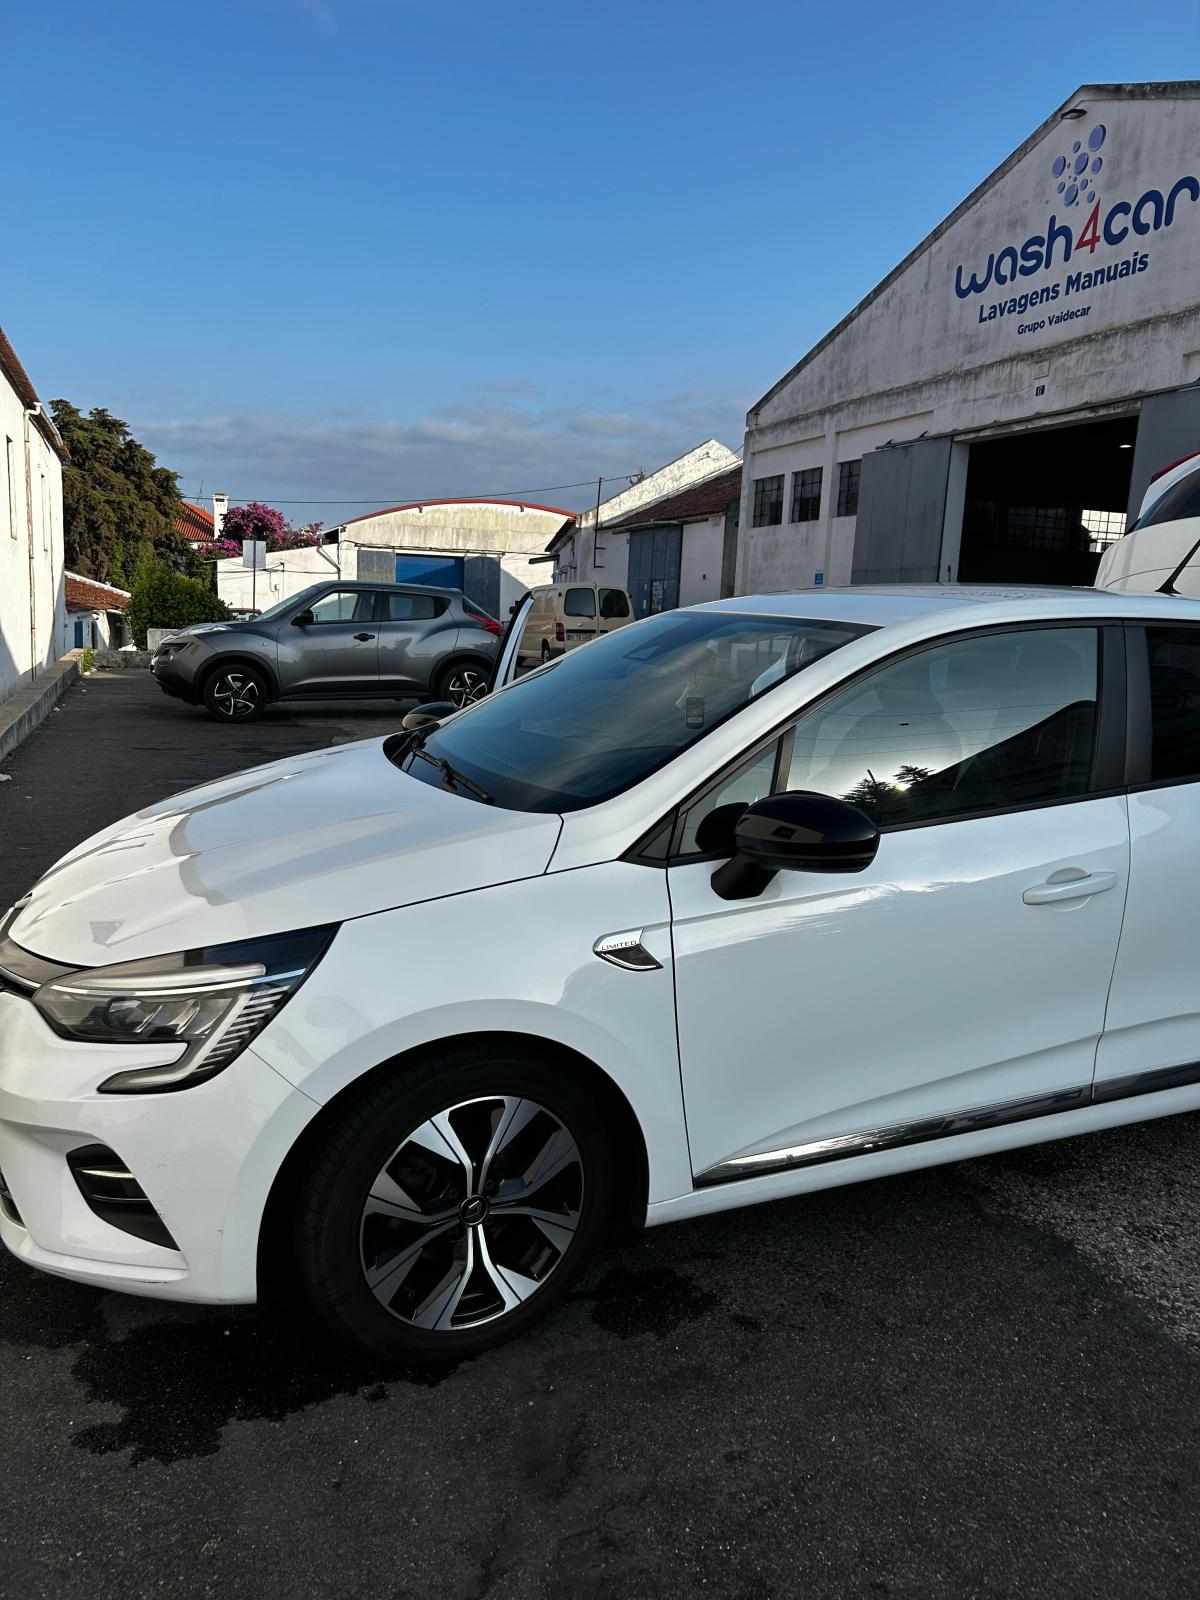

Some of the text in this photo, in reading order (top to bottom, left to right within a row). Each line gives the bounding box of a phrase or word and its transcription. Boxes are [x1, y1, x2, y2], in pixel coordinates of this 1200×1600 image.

[955, 175, 1200, 298] wash4car
[978, 251, 1149, 324] Lavagens Manuais
[1017, 305, 1092, 335] Grupo Vaidecar
[601, 940, 637, 951] LIMITED
